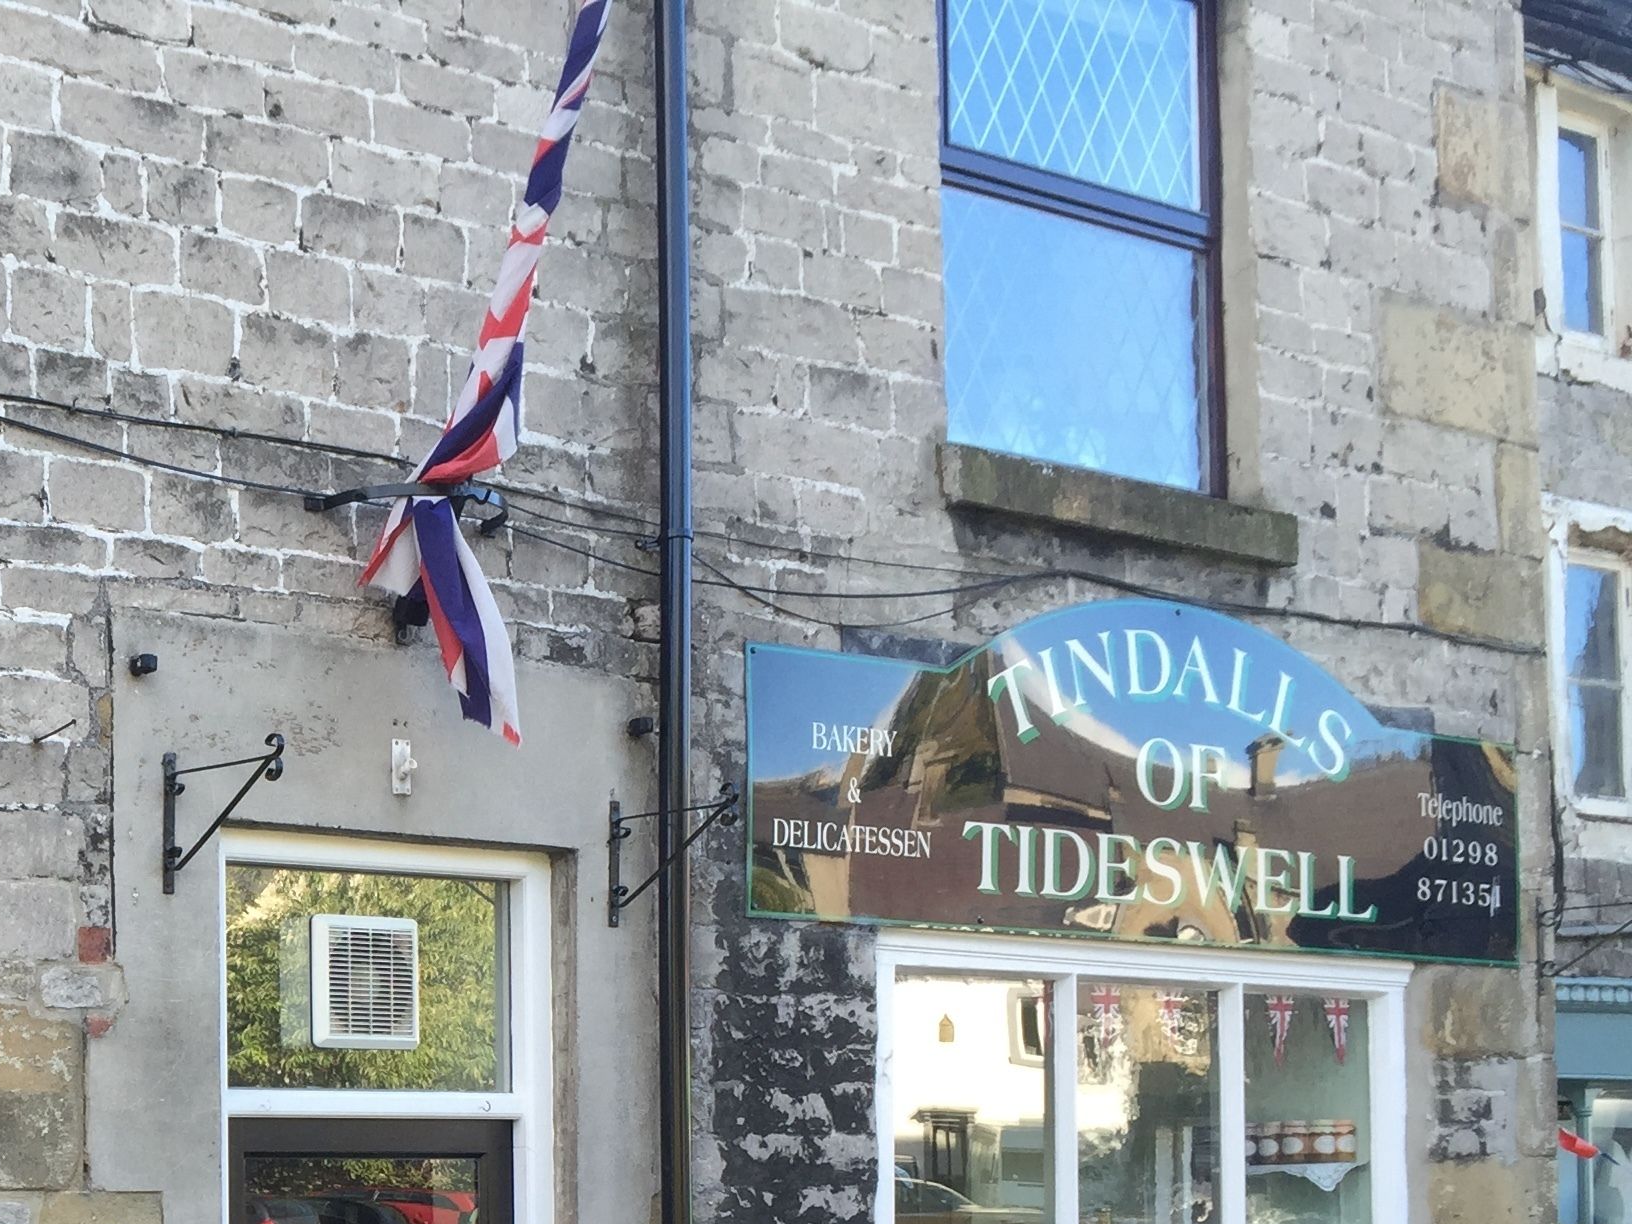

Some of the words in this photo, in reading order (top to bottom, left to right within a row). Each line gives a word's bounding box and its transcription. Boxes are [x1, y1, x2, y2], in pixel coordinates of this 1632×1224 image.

[987, 629, 1355, 781] TINDALLS
[811, 721, 898, 757] BAKERY
[847, 776, 862, 804] &
[1136, 736, 1227, 814] OF
[1417, 792, 1503, 827] Telephone
[772, 817, 932, 859] DELICATESSEN
[1423, 836, 1499, 866] 01298
[962, 820, 1377, 922] TIDESWELL
